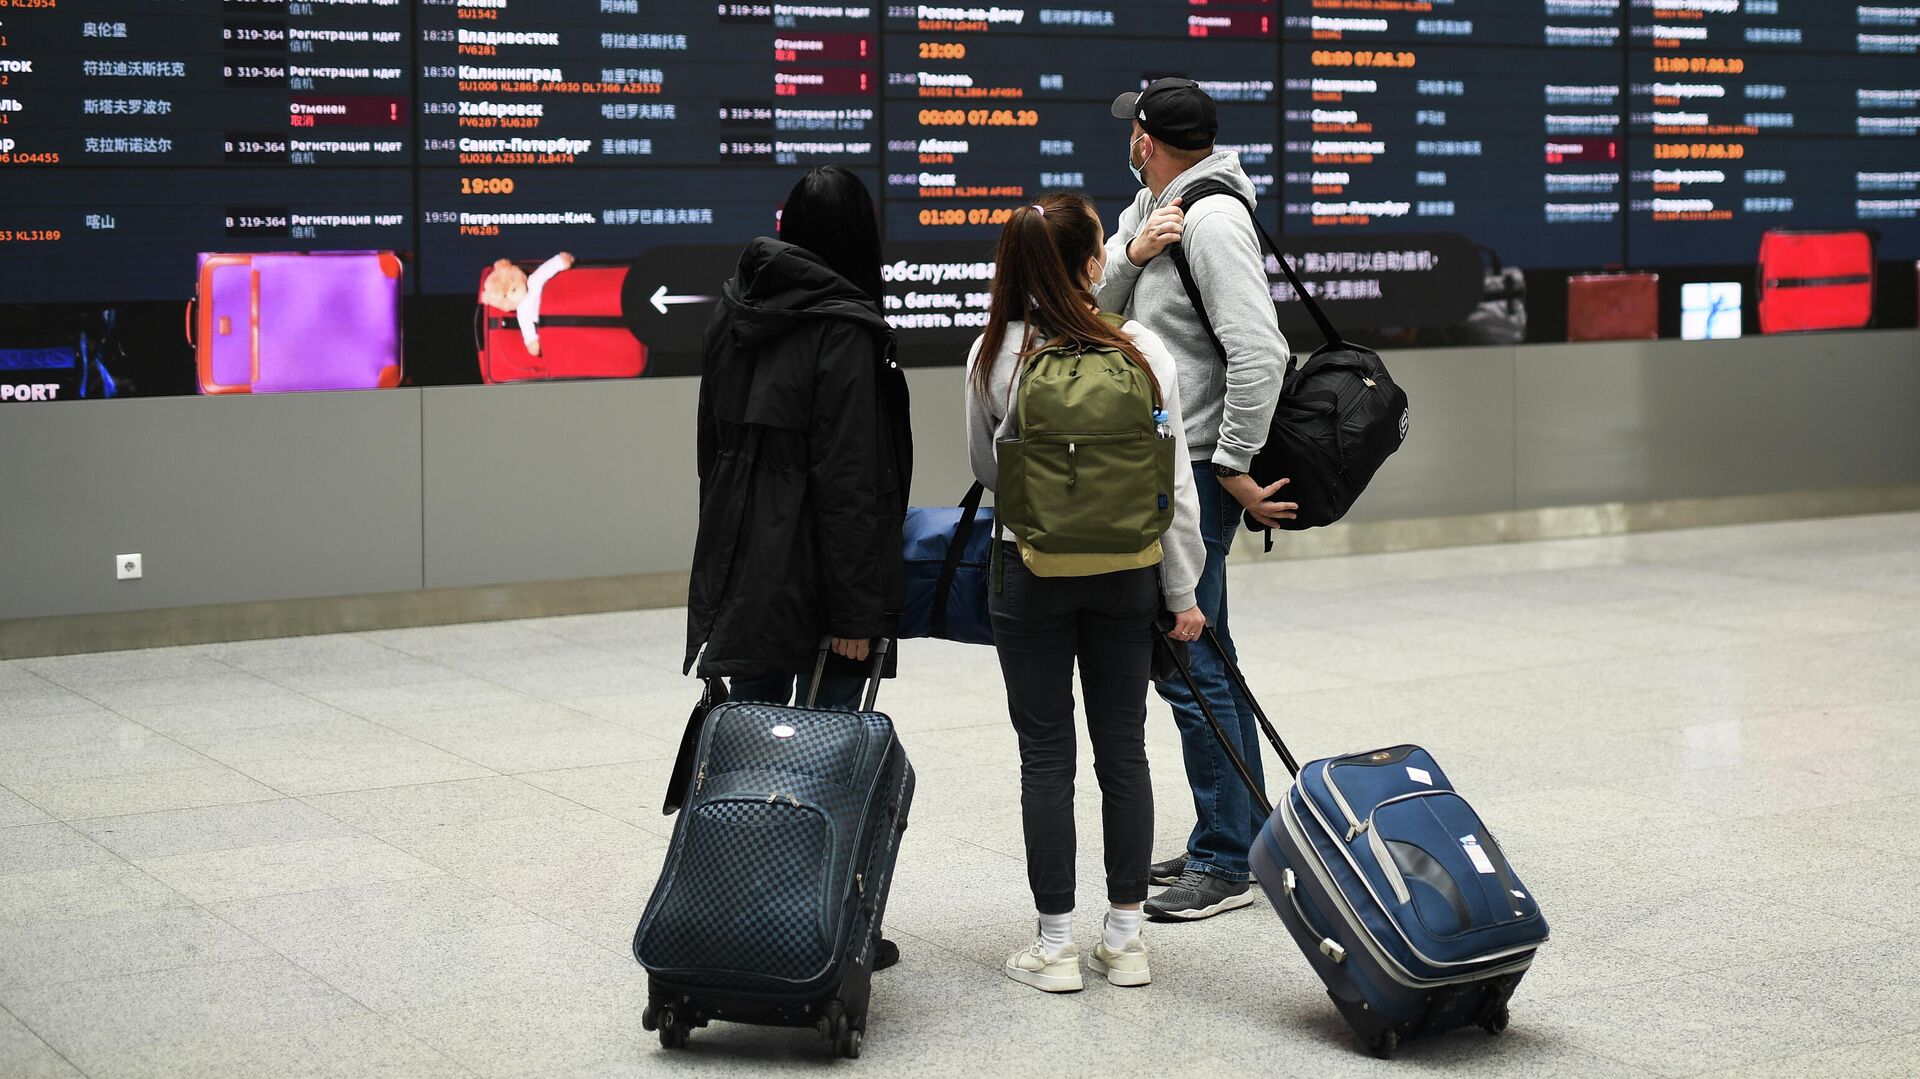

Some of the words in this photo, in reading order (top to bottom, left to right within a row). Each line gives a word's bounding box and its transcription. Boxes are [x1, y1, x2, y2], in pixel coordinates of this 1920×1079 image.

[457, 10, 497, 20] SU1542
[730, 5, 771, 16] 319-364
[774, 4, 843, 17] Регистрация
[845, 8, 871, 18] идет
[918, 5, 1024, 24] Ростов-на-Дону
[83, 22, 127, 37] 奥伦堡
[237, 29, 284, 40] 319-364
[289, 28, 368, 42] Регистрация
[373, 30, 400, 42] идет
[423, 30, 454, 41] 18:25
[458, 29, 559, 45] Владивосток
[601, 34, 687, 50] 符拉迪沃斯托克
[458, 45, 496, 55] FV6281
[774, 39, 823, 50] Отменен
[919, 43, 965, 59] 23:00
[83, 60, 185, 76] 符拉迪沃斯托克
[237, 66, 284, 77] 319-364
[290, 66, 369, 79] Регистрация
[373, 68, 401, 79] идет
[423, 66, 455, 77] 18:30
[458, 65, 562, 82] Калининград
[601, 68, 663, 84] 加里宁格勒
[774, 73, 823, 84] Отменен
[918, 72, 973, 86] Тюмень
[83, 100, 171, 115] 斯塔夫罗波尔
[290, 103, 346, 114] Отменен
[423, 103, 456, 114] 18:30
[458, 101, 544, 118] Хабаровск
[601, 104, 676, 119] 哈巴罗夫斯克
[731, 109, 772, 119] 319-364
[459, 118, 497, 127] FV6287
[500, 118, 539, 127] SU6287
[919, 109, 966, 125] 00:00
[968, 110, 1039, 126] 07.06.20
[85, 137, 172, 152] 克拉斯诺达尔
[238, 142, 285, 153] 319-364
[290, 141, 370, 153] Регистрация
[374, 142, 402, 153] идет
[424, 139, 455, 150] 18:45
[459, 137, 591, 154] Санкт-Петербург
[602, 139, 652, 155] 圣彼得堡
[731, 143, 772, 154] 319-364
[775, 142, 844, 154] Регистрация
[846, 143, 871, 154] идет
[918, 138, 968, 153] Абакан
[13, 153, 60, 163] LO4455
[461, 178, 514, 194] 19:00
[919, 172, 956, 187] Омск
[85, 214, 115, 229] 喀山
[239, 217, 286, 227] 319-364
[291, 215, 370, 227] Регистрация
[374, 215, 403, 226] идет
[424, 212, 457, 223] 19:50
[460, 212, 596, 227] Петропавловск-Кмч.
[919, 209, 966, 225] 01:00
[16, 231, 61, 241] KL3189
[905, 291, 962, 310] багаж,
[0, 384, 60, 401] PORT
